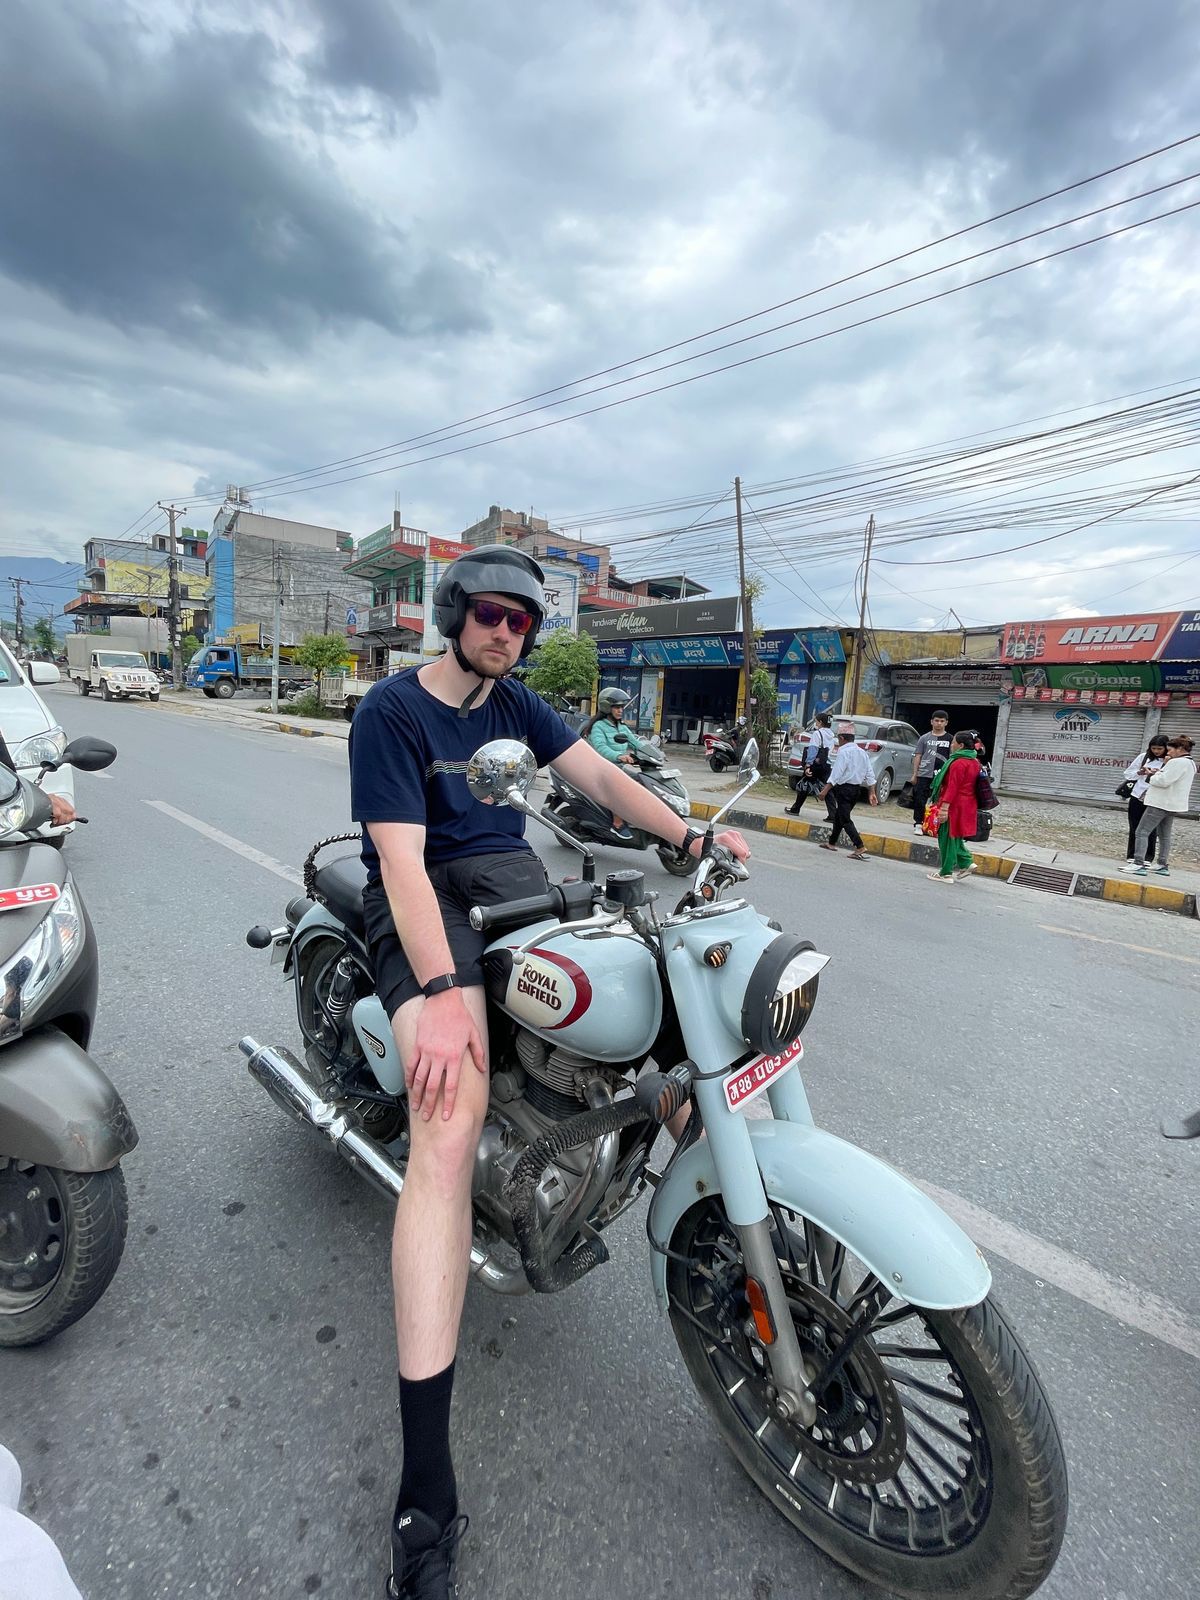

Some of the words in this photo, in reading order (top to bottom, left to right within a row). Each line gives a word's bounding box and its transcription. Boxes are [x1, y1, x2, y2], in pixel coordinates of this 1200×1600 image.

[616, 612, 648, 631] italian
[630, 626, 654, 634] collection
[1058, 623, 1159, 645] ARNA
[1073, 676, 1142, 685] TUBORG
[1061, 722, 1090, 731] AWW
[1006, 751, 1046, 761] ANNAPURNA
[1048, 754, 1080, 764] WINDING
[1083, 756, 1110, 766] WIRES
[523, 963, 557, 993] ROYAL
[517, 978, 562, 1011] ENFIELD
